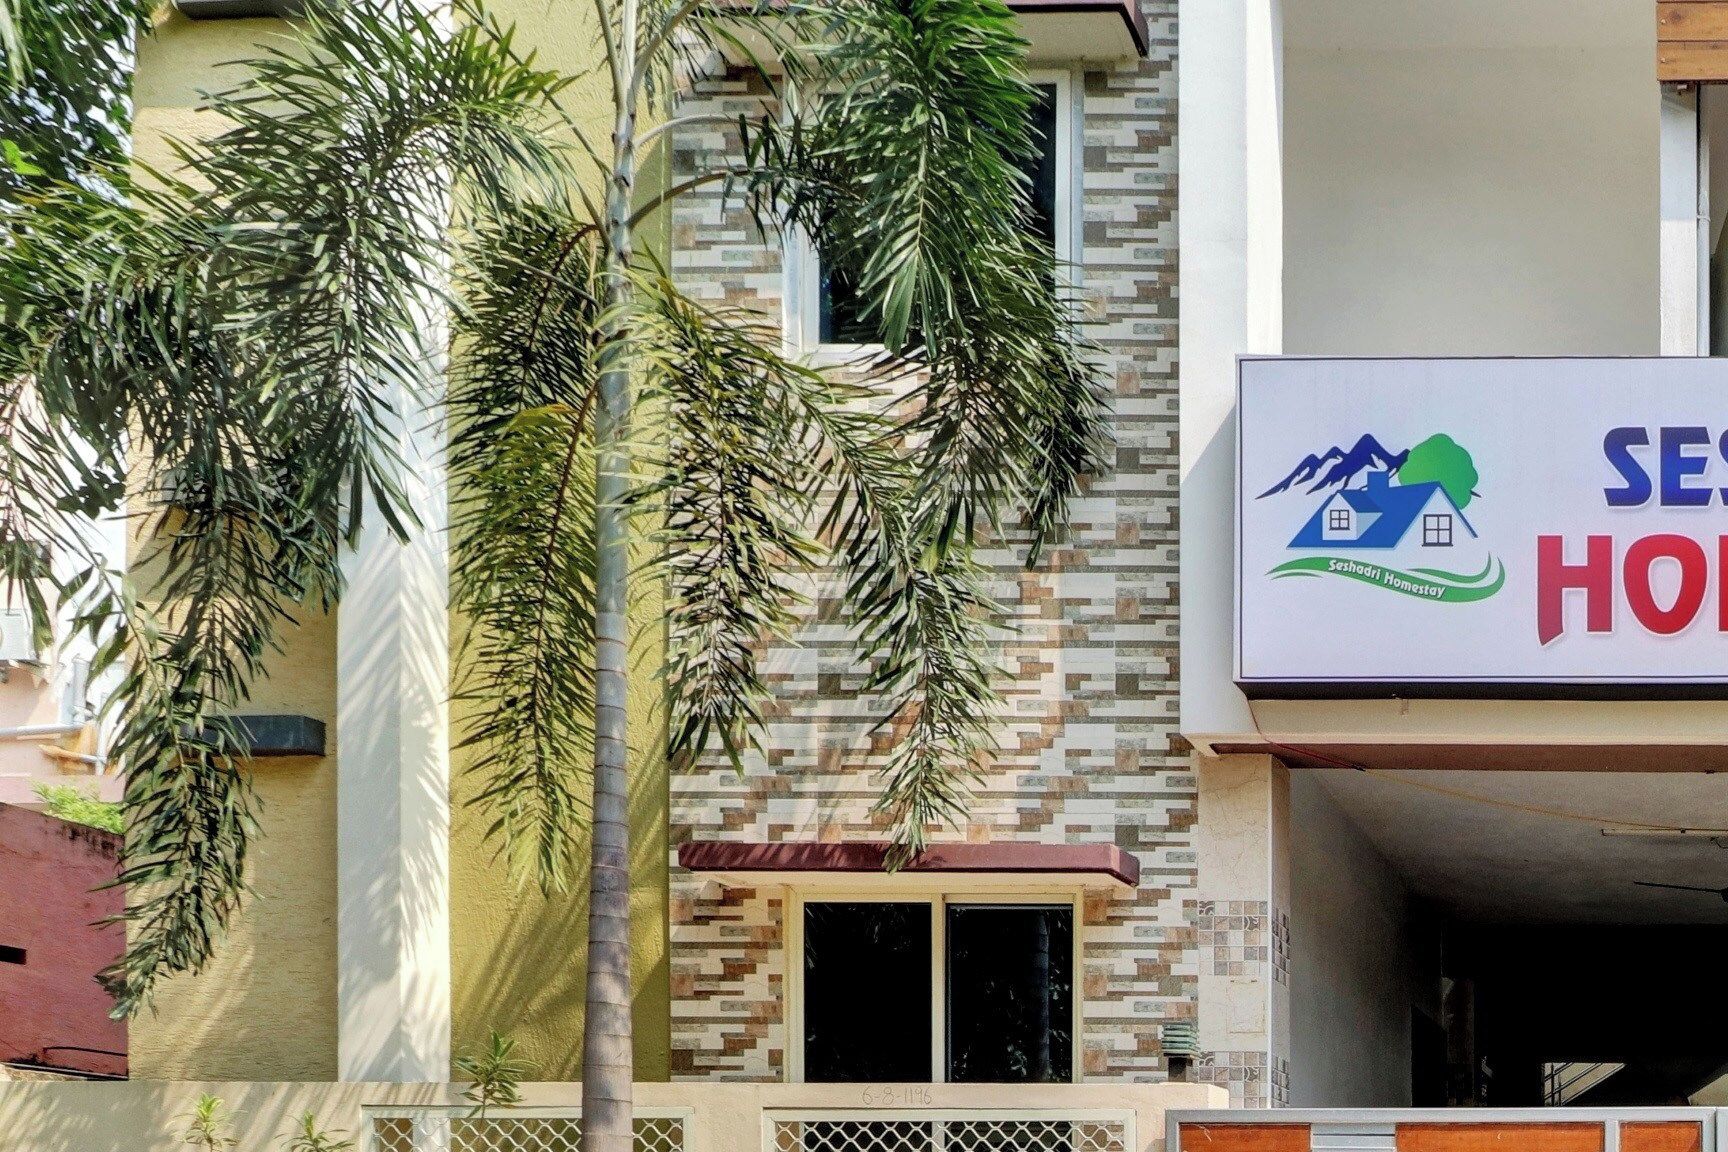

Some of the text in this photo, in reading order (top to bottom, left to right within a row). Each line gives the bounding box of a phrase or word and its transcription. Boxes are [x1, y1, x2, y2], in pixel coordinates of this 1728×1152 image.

[1328, 559, 1446, 599] Seshadri Homestay
[862, 1080, 933, 1105] 6-8-1196
